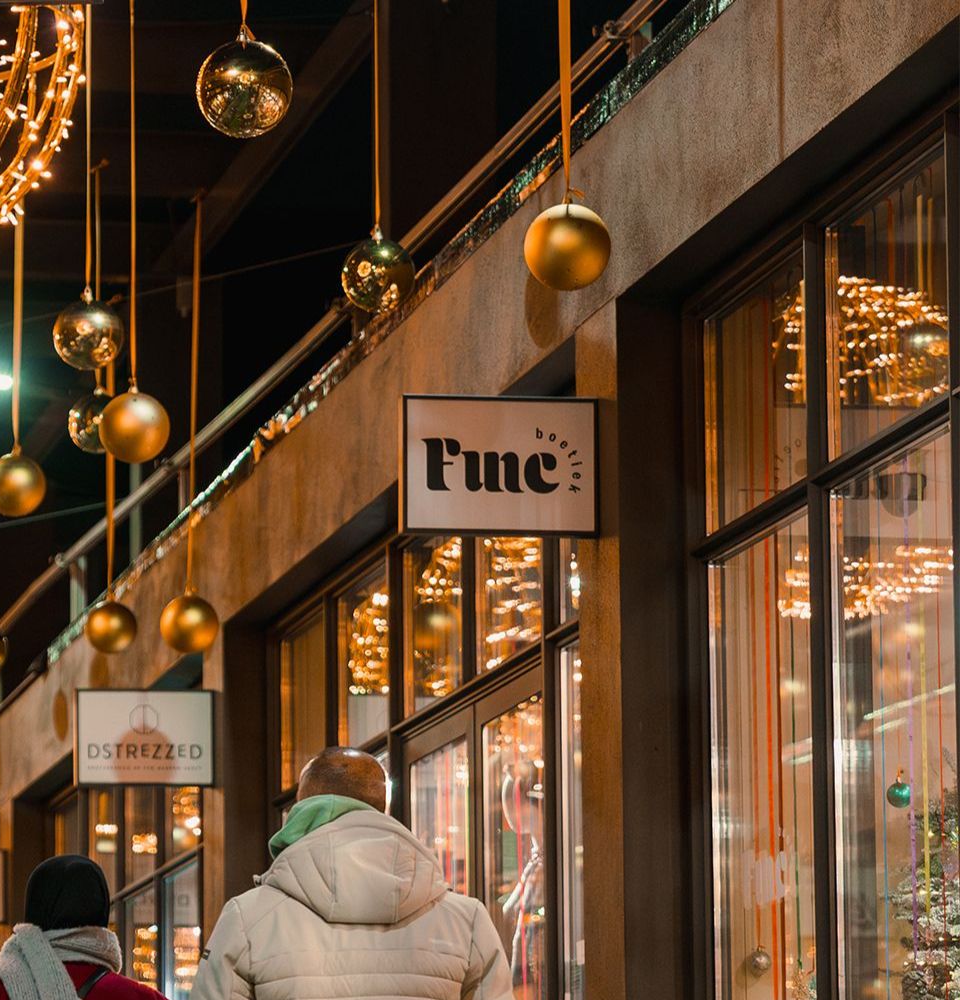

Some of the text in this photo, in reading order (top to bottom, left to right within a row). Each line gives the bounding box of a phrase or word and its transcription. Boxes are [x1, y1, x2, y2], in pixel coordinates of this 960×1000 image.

[421, 437, 560, 494] Func
[535, 427, 583, 494] boetiek
[87, 742, 203, 761] DSTREZZED
